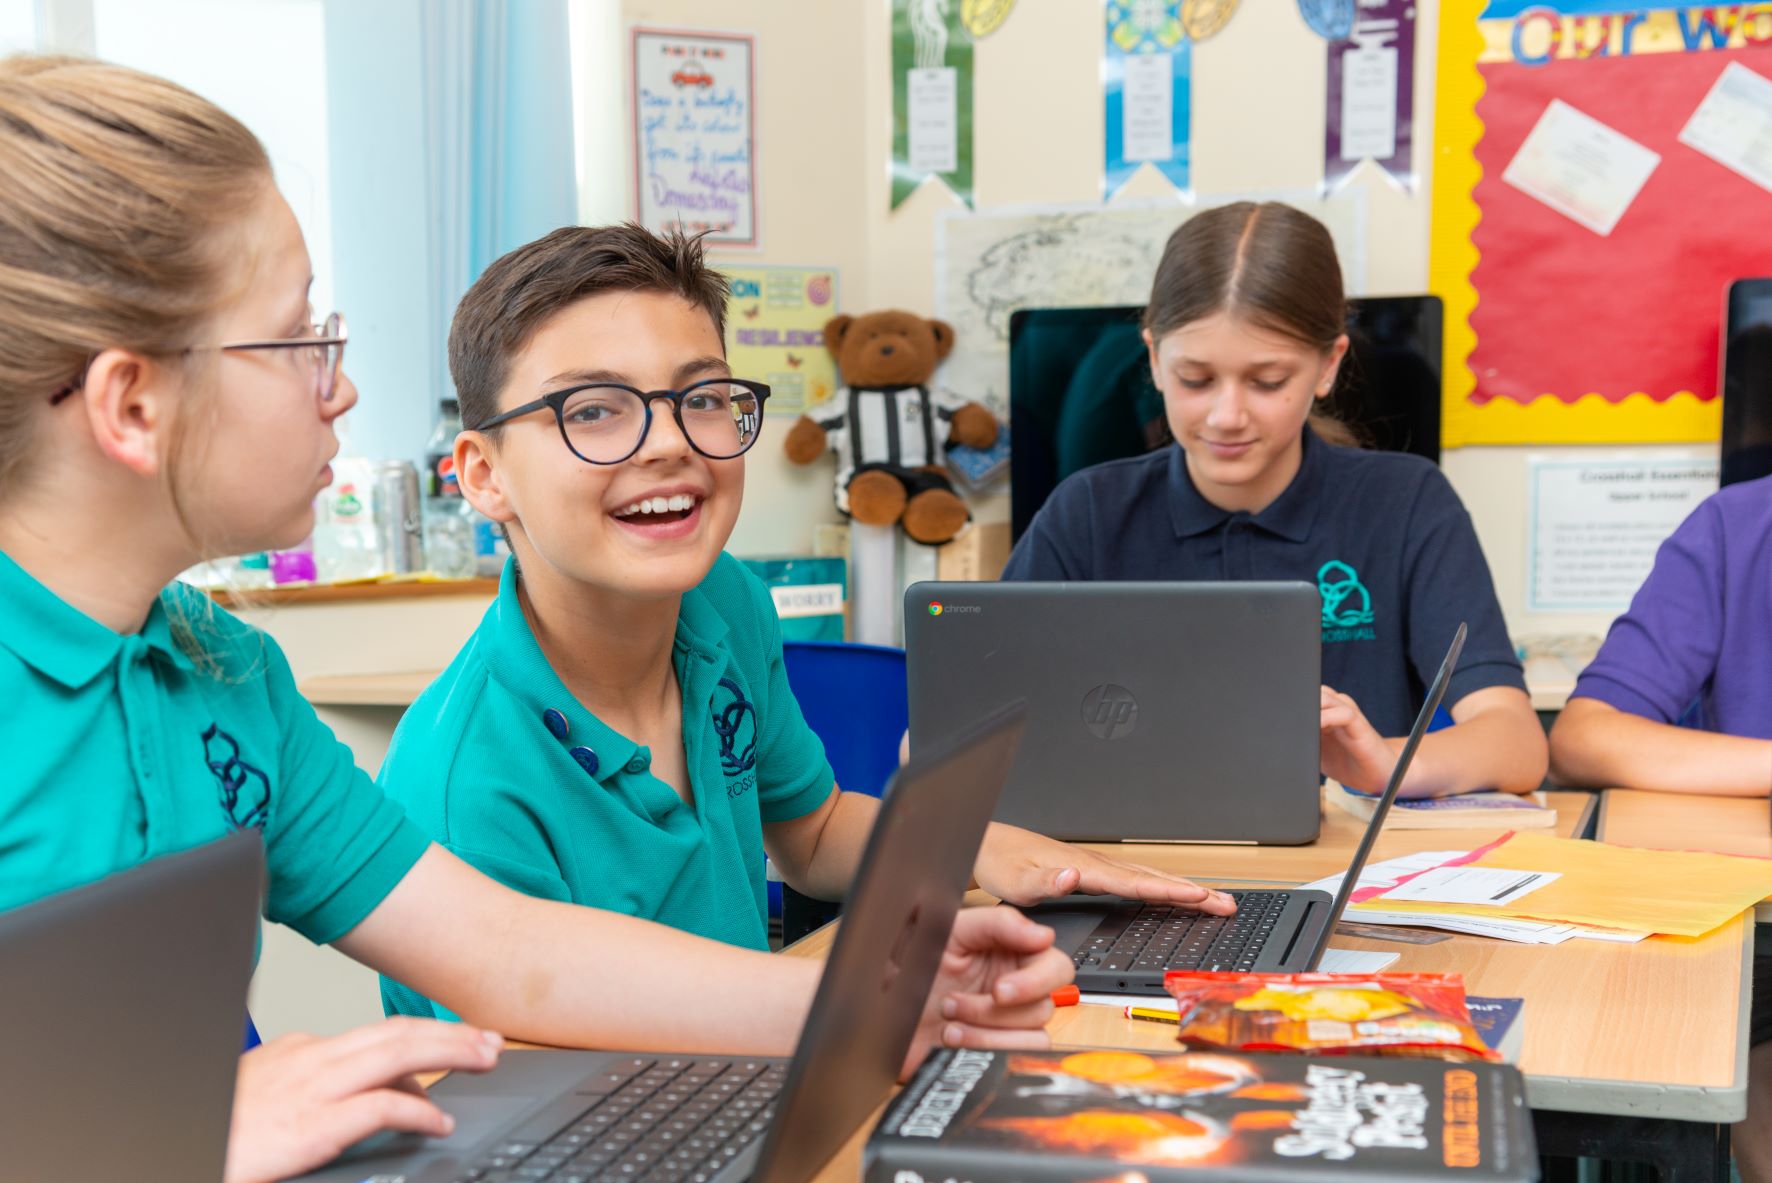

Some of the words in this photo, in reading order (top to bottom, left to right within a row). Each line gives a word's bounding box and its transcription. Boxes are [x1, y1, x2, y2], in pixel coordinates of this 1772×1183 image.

[1510, 6, 1648, 68] Our
[731, 279, 761, 298] ON
[736, 328, 825, 347] RESILIENC
[944, 602, 982, 614] chrome
[1083, 684, 1140, 740] hp
